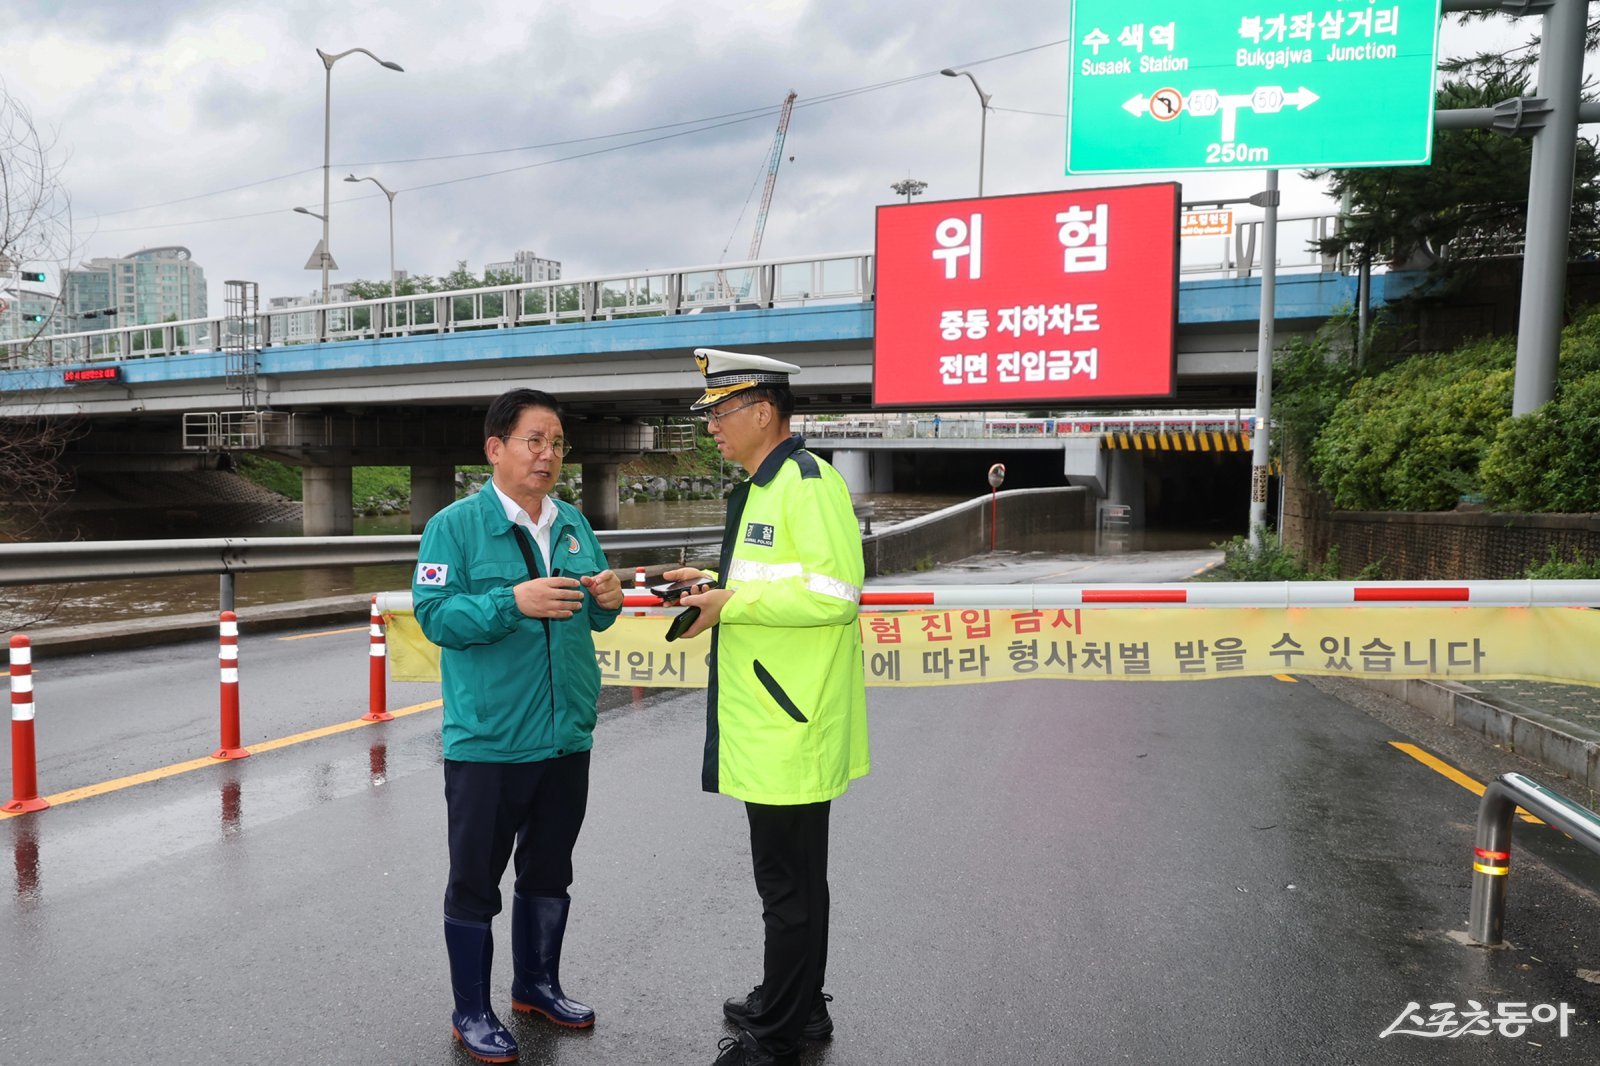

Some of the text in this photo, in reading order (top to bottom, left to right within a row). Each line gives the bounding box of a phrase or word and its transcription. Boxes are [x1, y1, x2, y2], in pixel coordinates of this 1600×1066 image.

[1082, 21, 1175, 56] 수색역
[1238, 6, 1399, 44] 북가좌삼거리
[1081, 54, 1189, 76] Susaek Station
[1236, 42, 1397, 70] Bukgajwa Junction
[1193, 93, 1213, 112] 50
[1258, 91, 1278, 109] 50
[1205, 142, 1269, 163] 250m
[996, 303, 1100, 337] 지하차도
[939, 347, 1098, 385] 전면 진입금지
[858, 617, 902, 644] 험
[921, 609, 992, 642] 진입
[595, 632, 1486, 682] 진입시 에 따라 형사처벌 받을 수 있습니다
